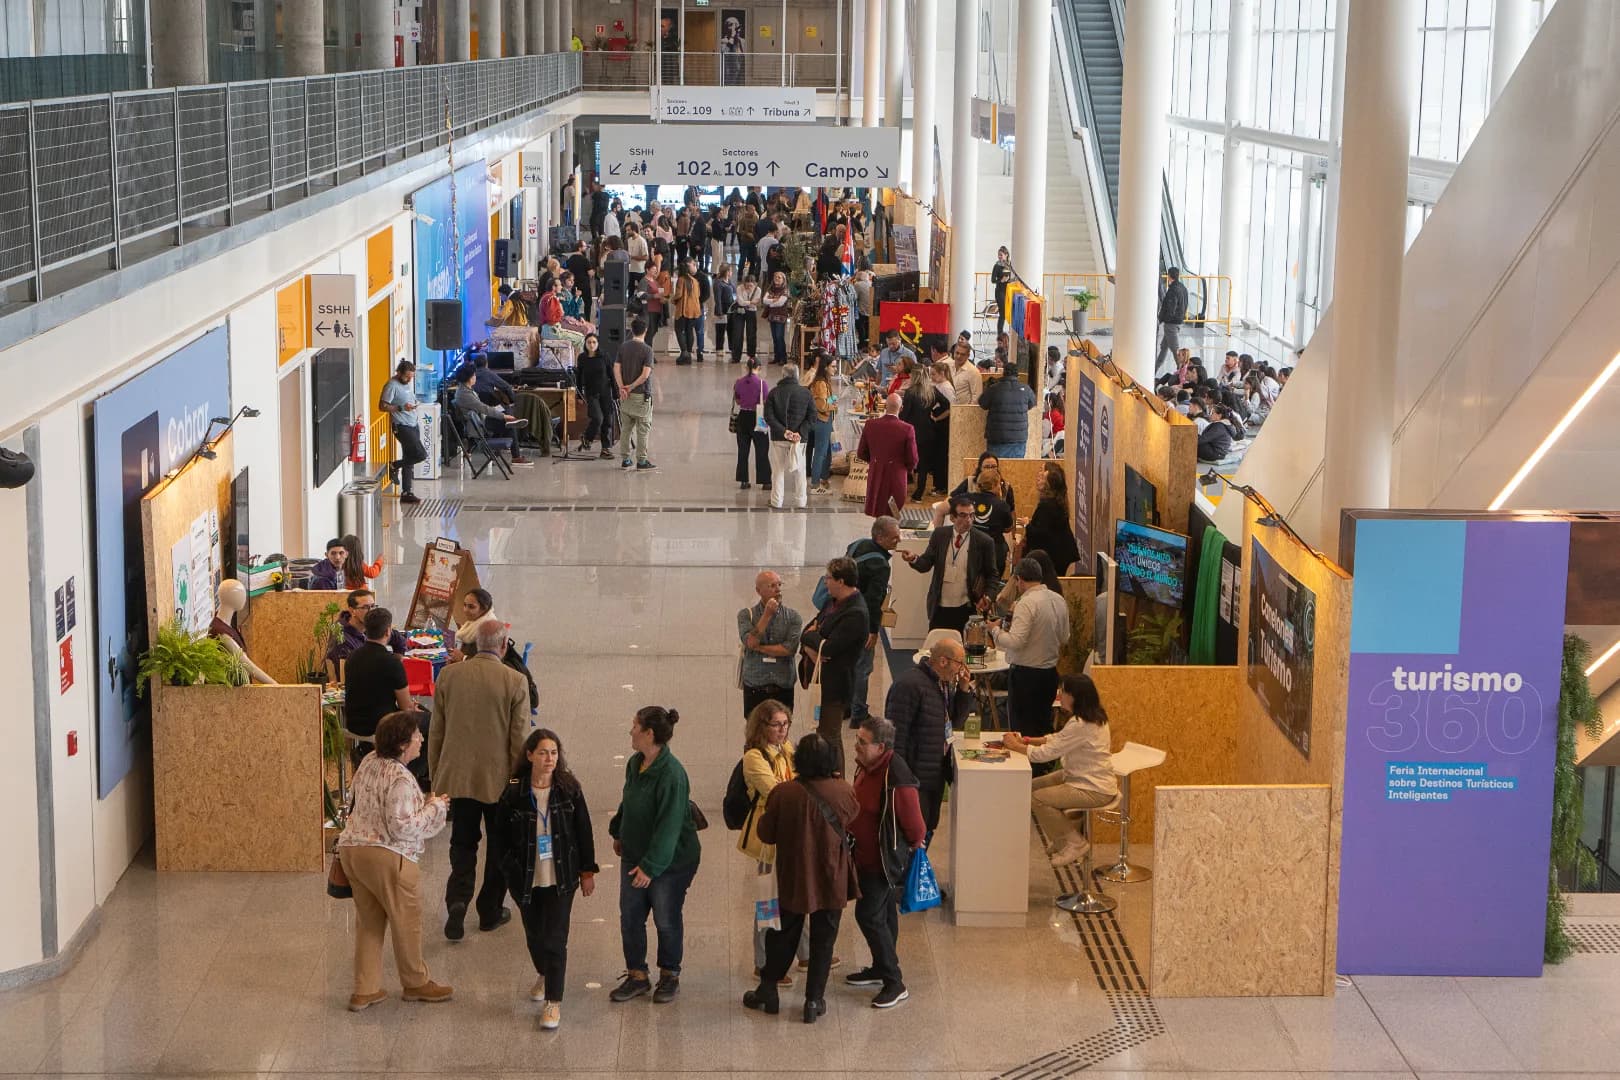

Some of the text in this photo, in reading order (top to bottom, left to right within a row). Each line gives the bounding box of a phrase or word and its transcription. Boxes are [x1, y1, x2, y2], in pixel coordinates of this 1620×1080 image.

[666, 106, 686, 115] 102
[693, 106, 712, 115] 109
[763, 107, 800, 117] Tribuna
[629, 148, 654, 156] SSHH
[722, 148, 759, 157] Sectores
[840, 150, 861, 158] Nivel
[677, 160, 711, 176] 102
[724, 161, 759, 177] 109
[805, 162, 869, 181] Campo
[318, 305, 350, 315] SSHH
[168, 400, 209, 463] Cobrar
[1261, 593, 1294, 650] Canelones
[1260, 628, 1292, 693] Turismo
[1392, 663, 1522, 693] turismo
[1366, 679, 1543, 755] 360
[1389, 765, 1484, 776] Feria Internacional
[1389, 778, 1514, 789] sobre Destinos Turísticos
[1388, 790, 1449, 802] Inteligentes
